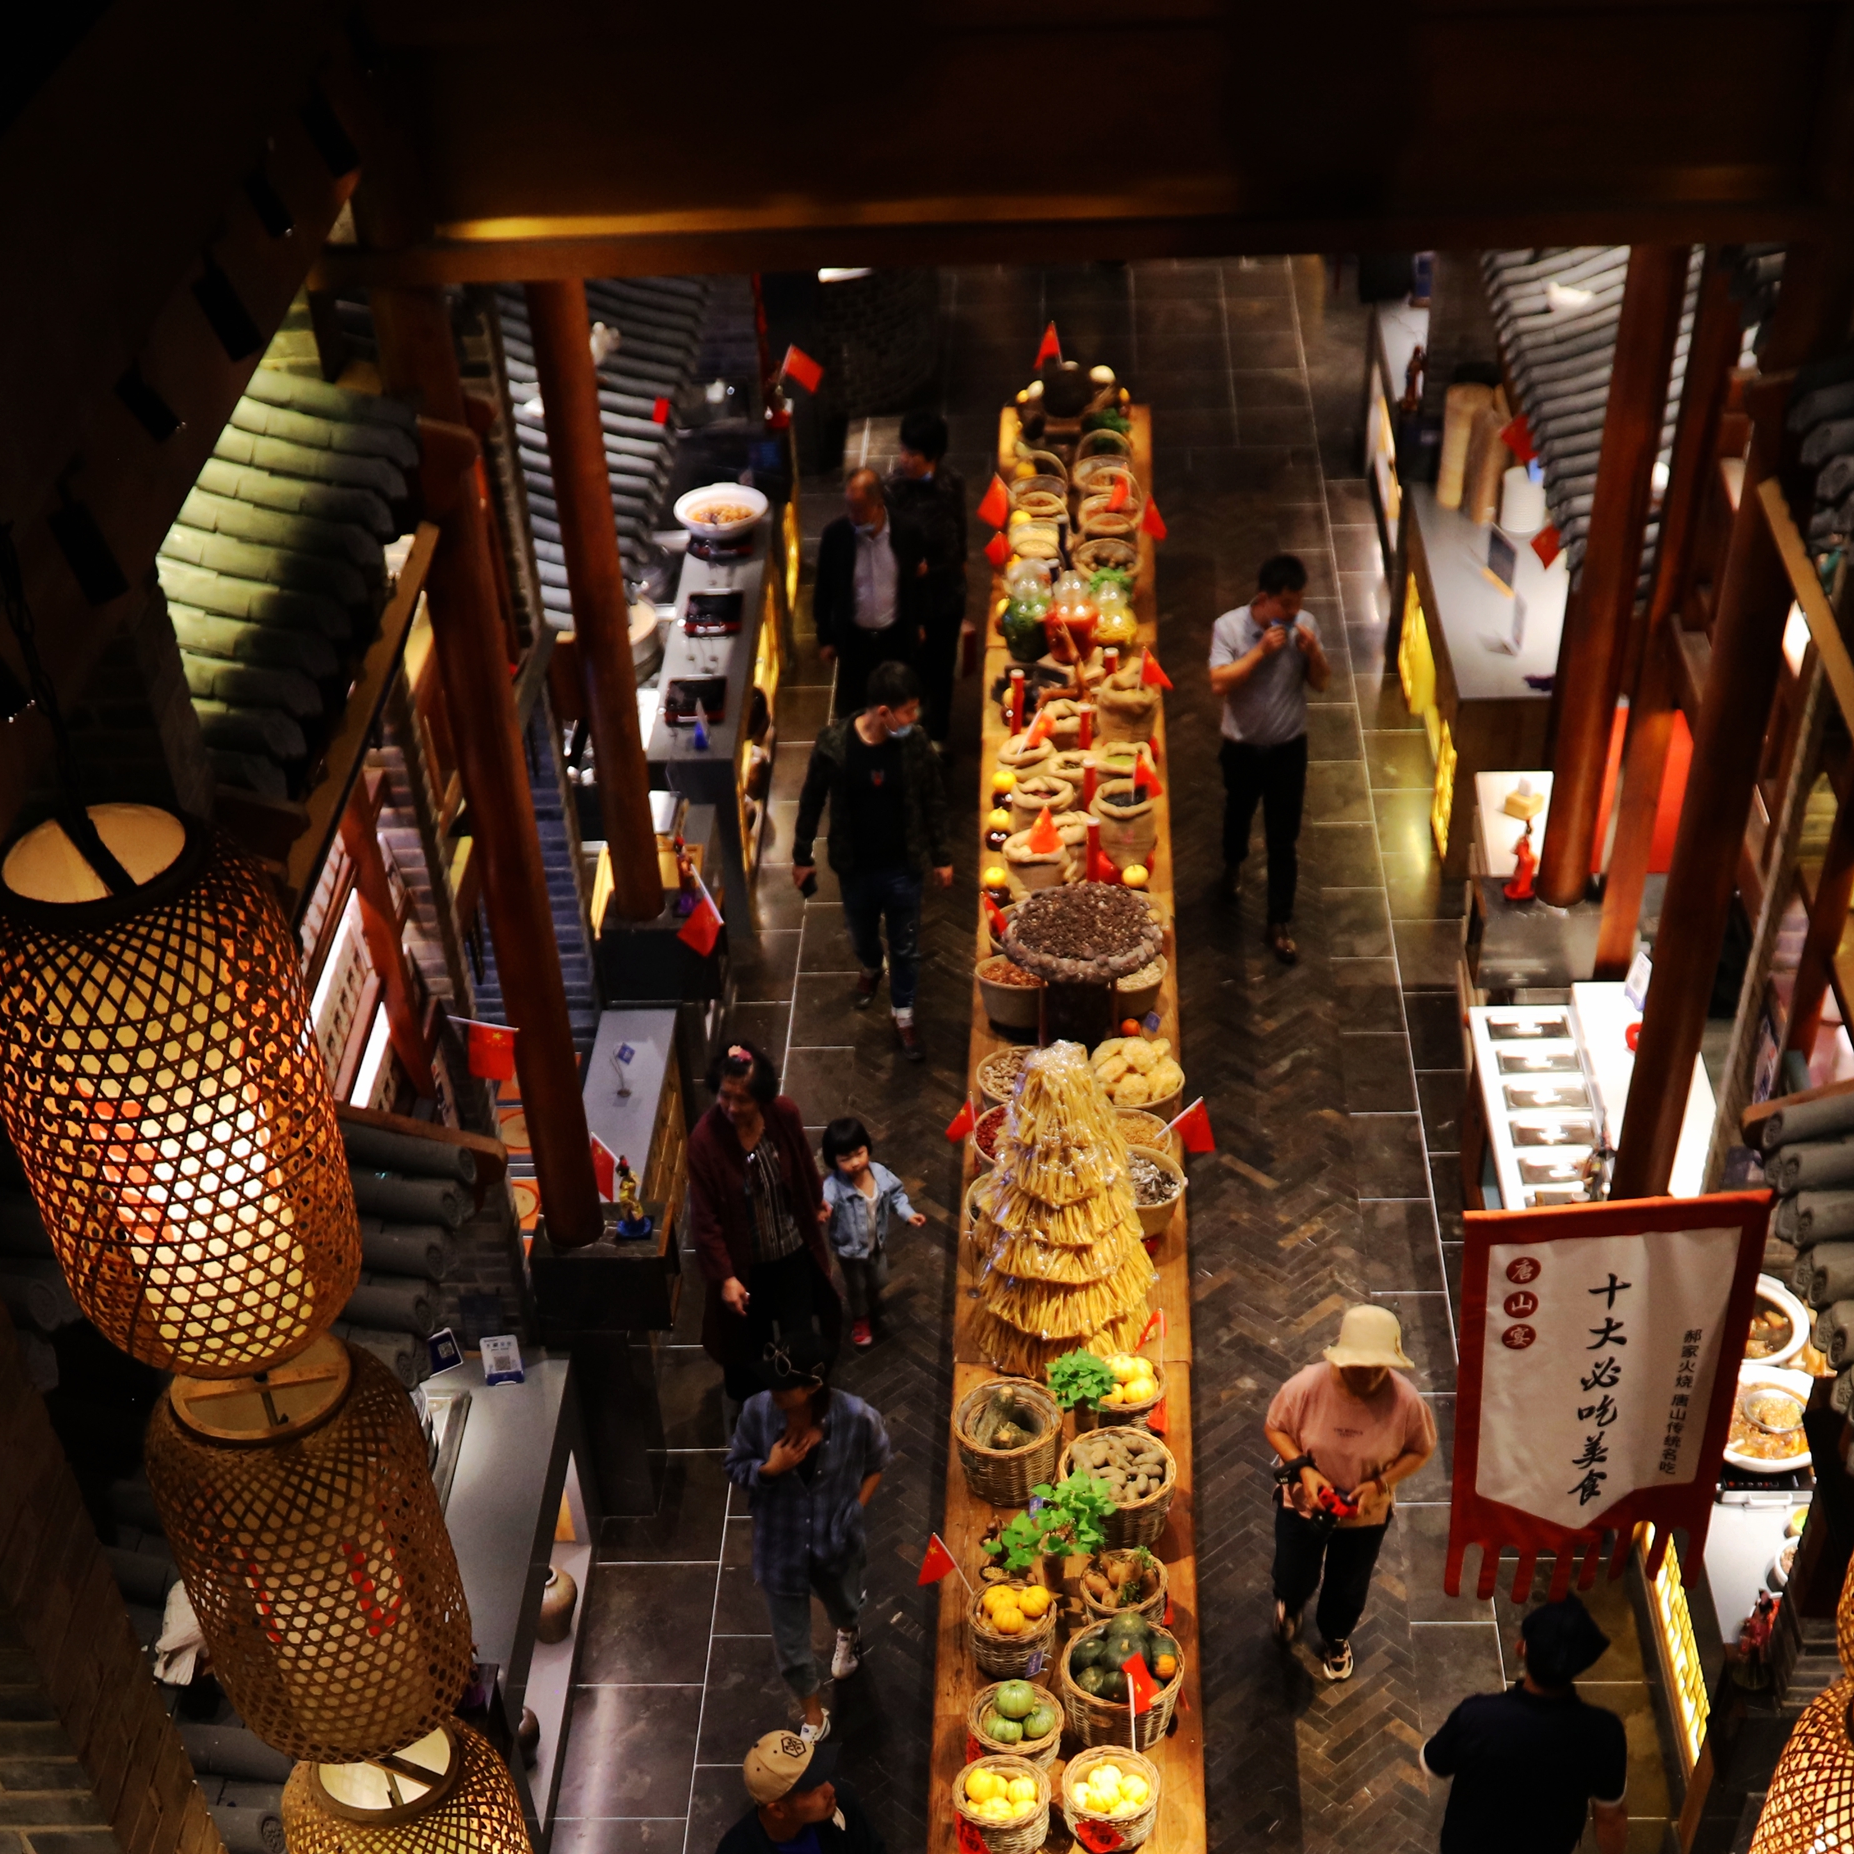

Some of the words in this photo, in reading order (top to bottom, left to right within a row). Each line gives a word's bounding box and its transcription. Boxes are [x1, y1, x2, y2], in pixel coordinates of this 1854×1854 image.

[1505, 1258, 1534, 1346] 唐山宴
[1567, 1273, 1632, 1506] 十大必吃美食
[1658, 1393, 1690, 1475] 唐山传统名吃
